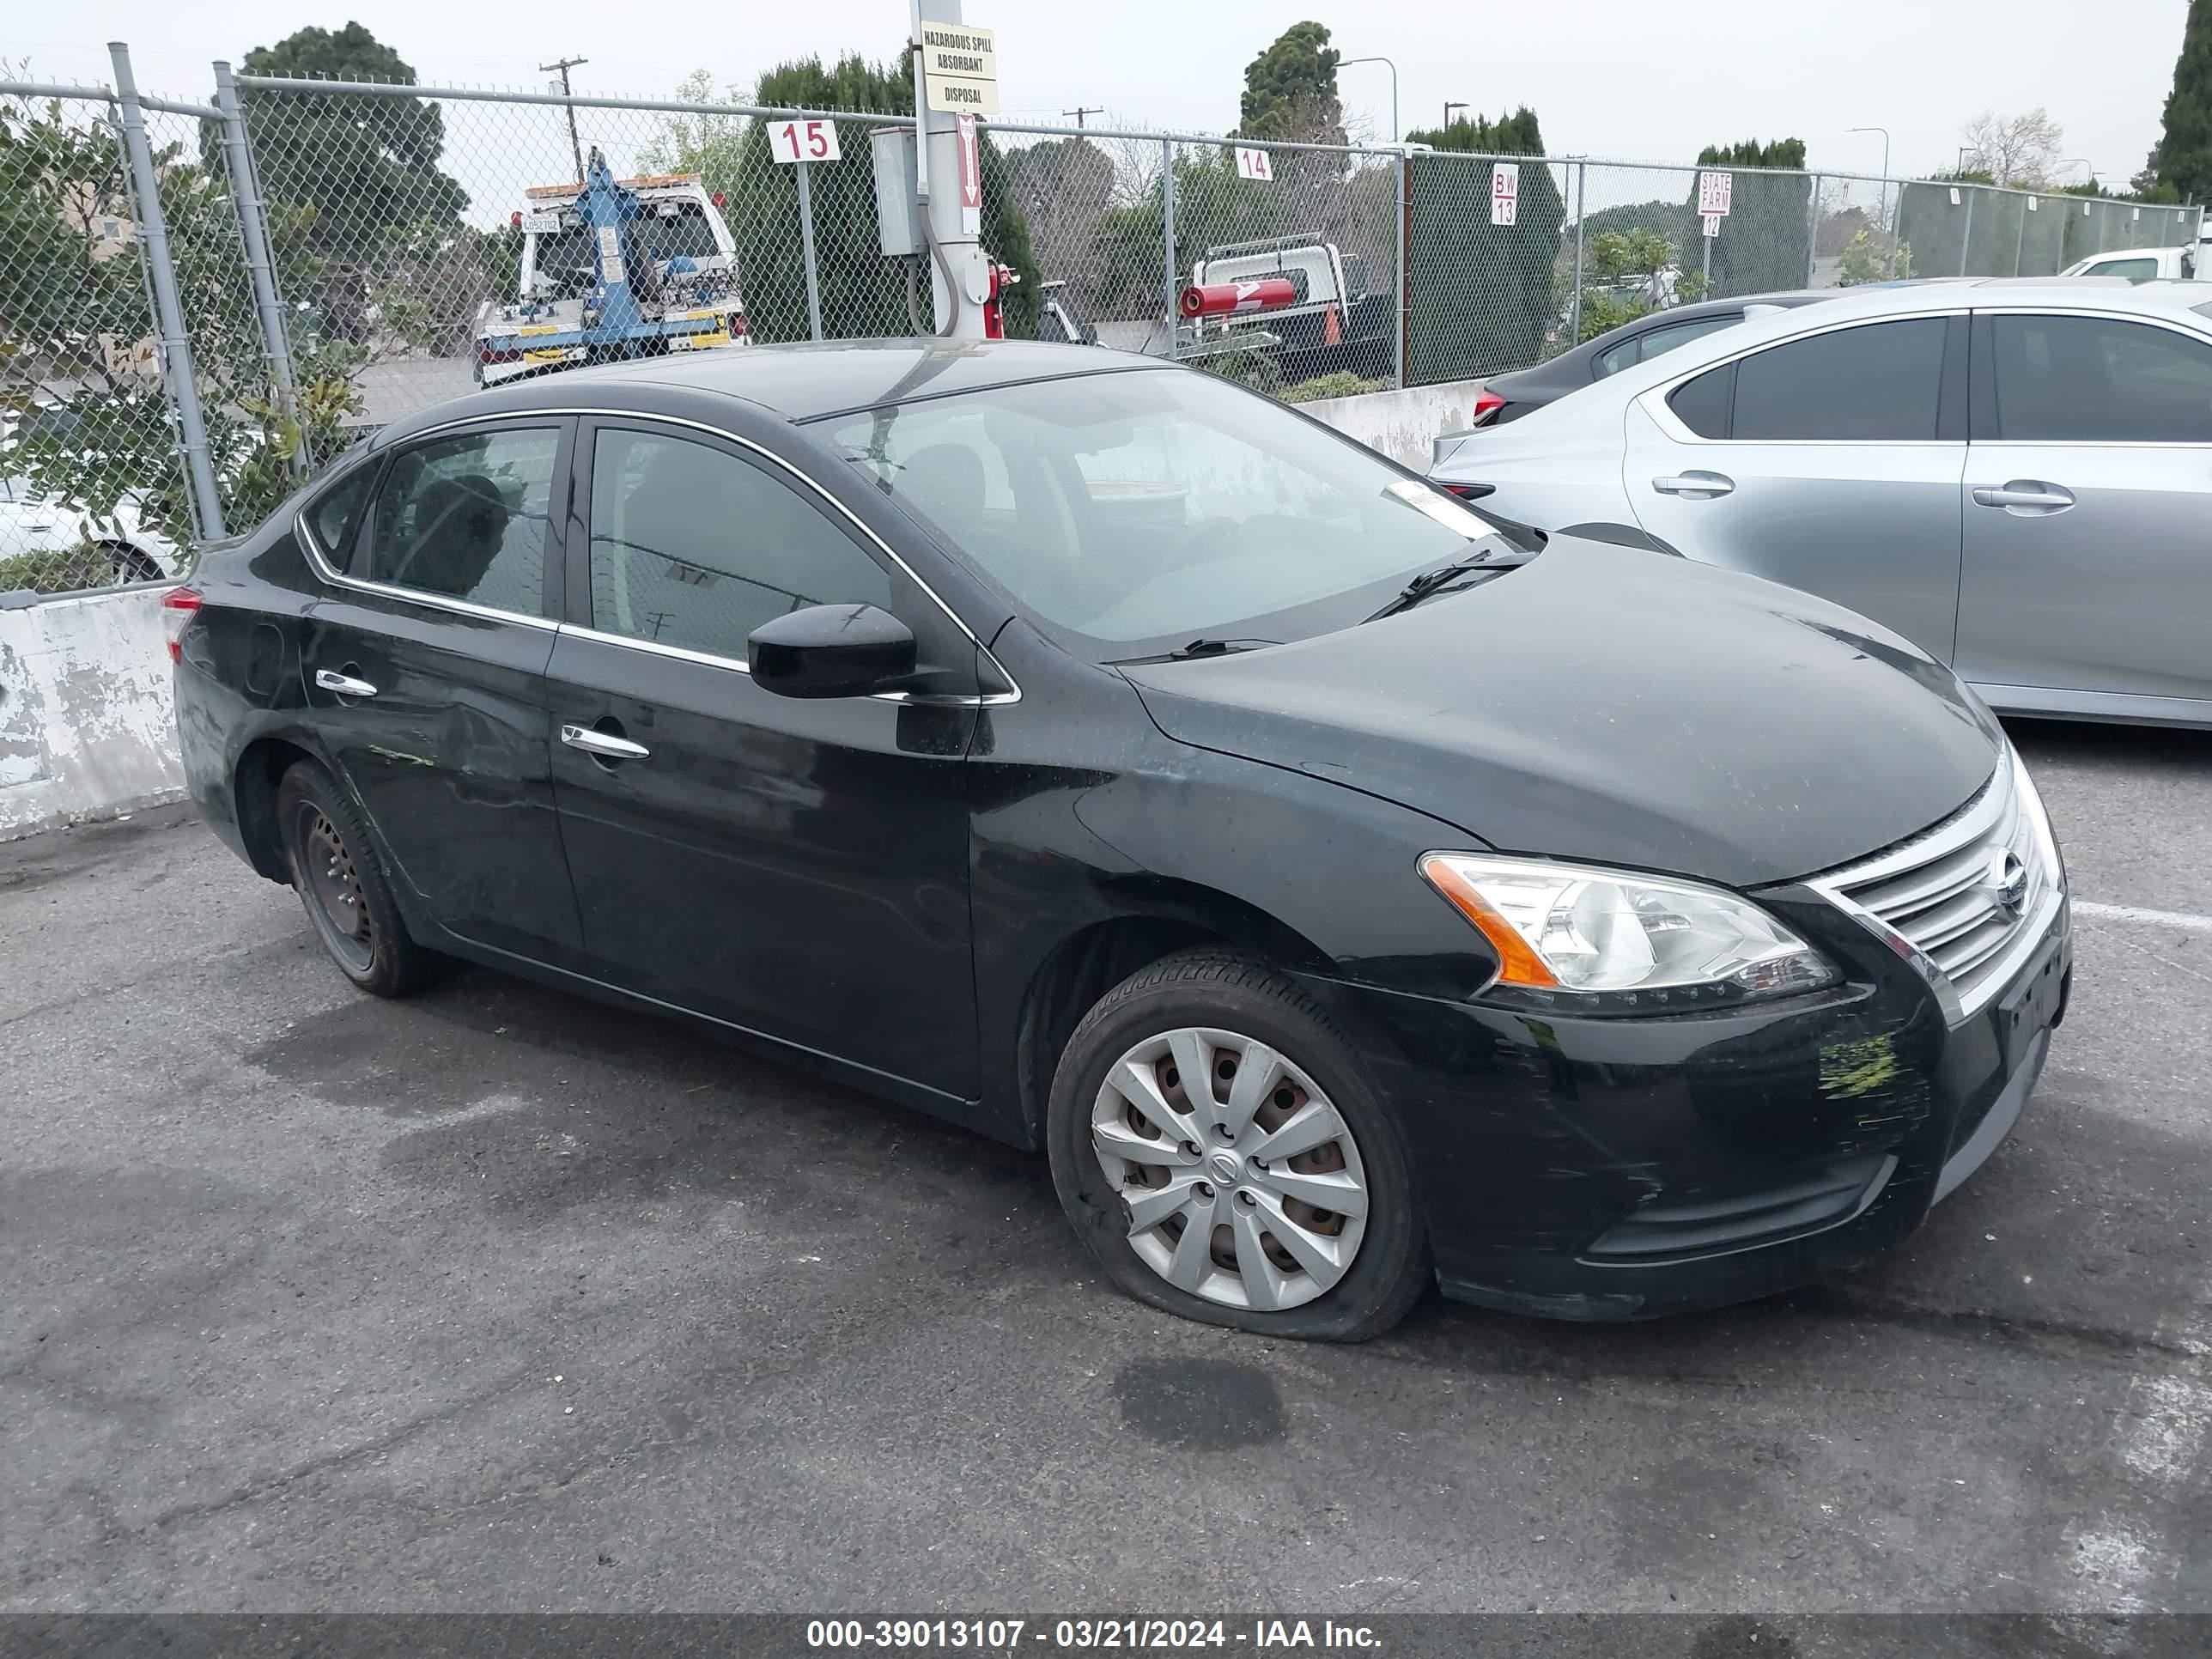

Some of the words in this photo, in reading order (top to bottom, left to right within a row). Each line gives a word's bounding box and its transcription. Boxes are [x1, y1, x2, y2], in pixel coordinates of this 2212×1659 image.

[924, 30, 971, 51] HAZARDOUS
[972, 37, 993, 52] SPILL
[938, 53, 983, 72] ABSORBANT
[945, 87, 982, 104] DISPOSAL
[782, 123, 828, 160] 15
[1243, 150, 1266, 178] 14
[1702, 173, 1730, 191] STATE
[1702, 191, 1729, 208] FARM
[1498, 200, 1513, 222] 13
[1707, 216, 1717, 234] 12
